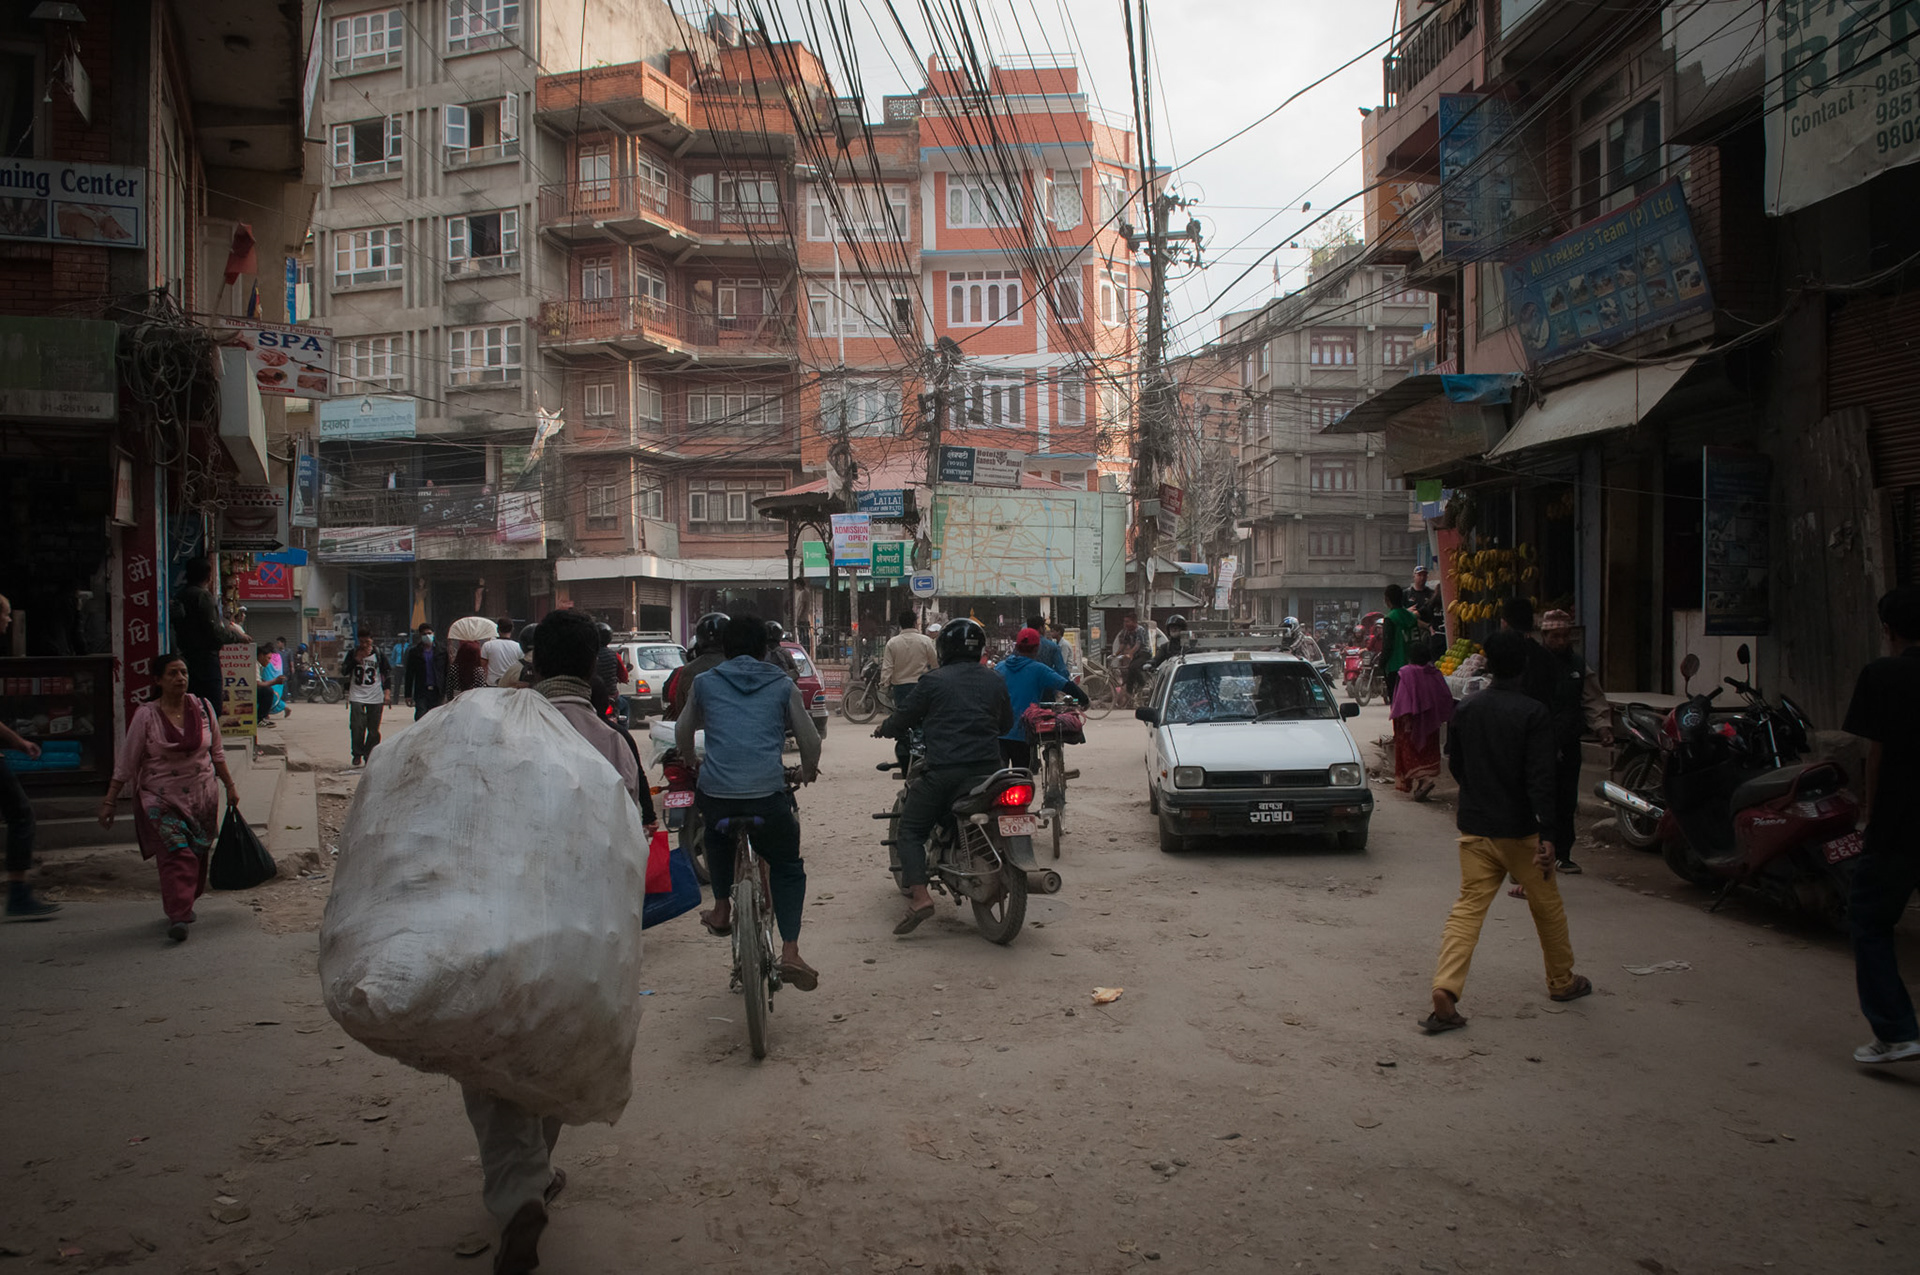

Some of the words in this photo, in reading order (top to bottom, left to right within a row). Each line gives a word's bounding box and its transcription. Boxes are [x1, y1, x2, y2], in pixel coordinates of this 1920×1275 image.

[1791, 90, 1855, 138] Contact
[60, 168, 138, 198] Center
[1531, 258, 1543, 277] All
[1545, 235, 1595, 267] Trekker's
[1594, 221, 1628, 246] Team
[1629, 206, 1649, 228] (P)
[1652, 194, 1679, 220] Ltd.
[256, 322, 287, 332] Beauty
[289, 325, 321, 336] Parlour
[258, 331, 324, 352] SPA
[977, 450, 996, 458] Hotel
[834, 525, 868, 534] ADMISSION
[225, 677, 249, 688] PA
[355, 665, 376, 686] 93
